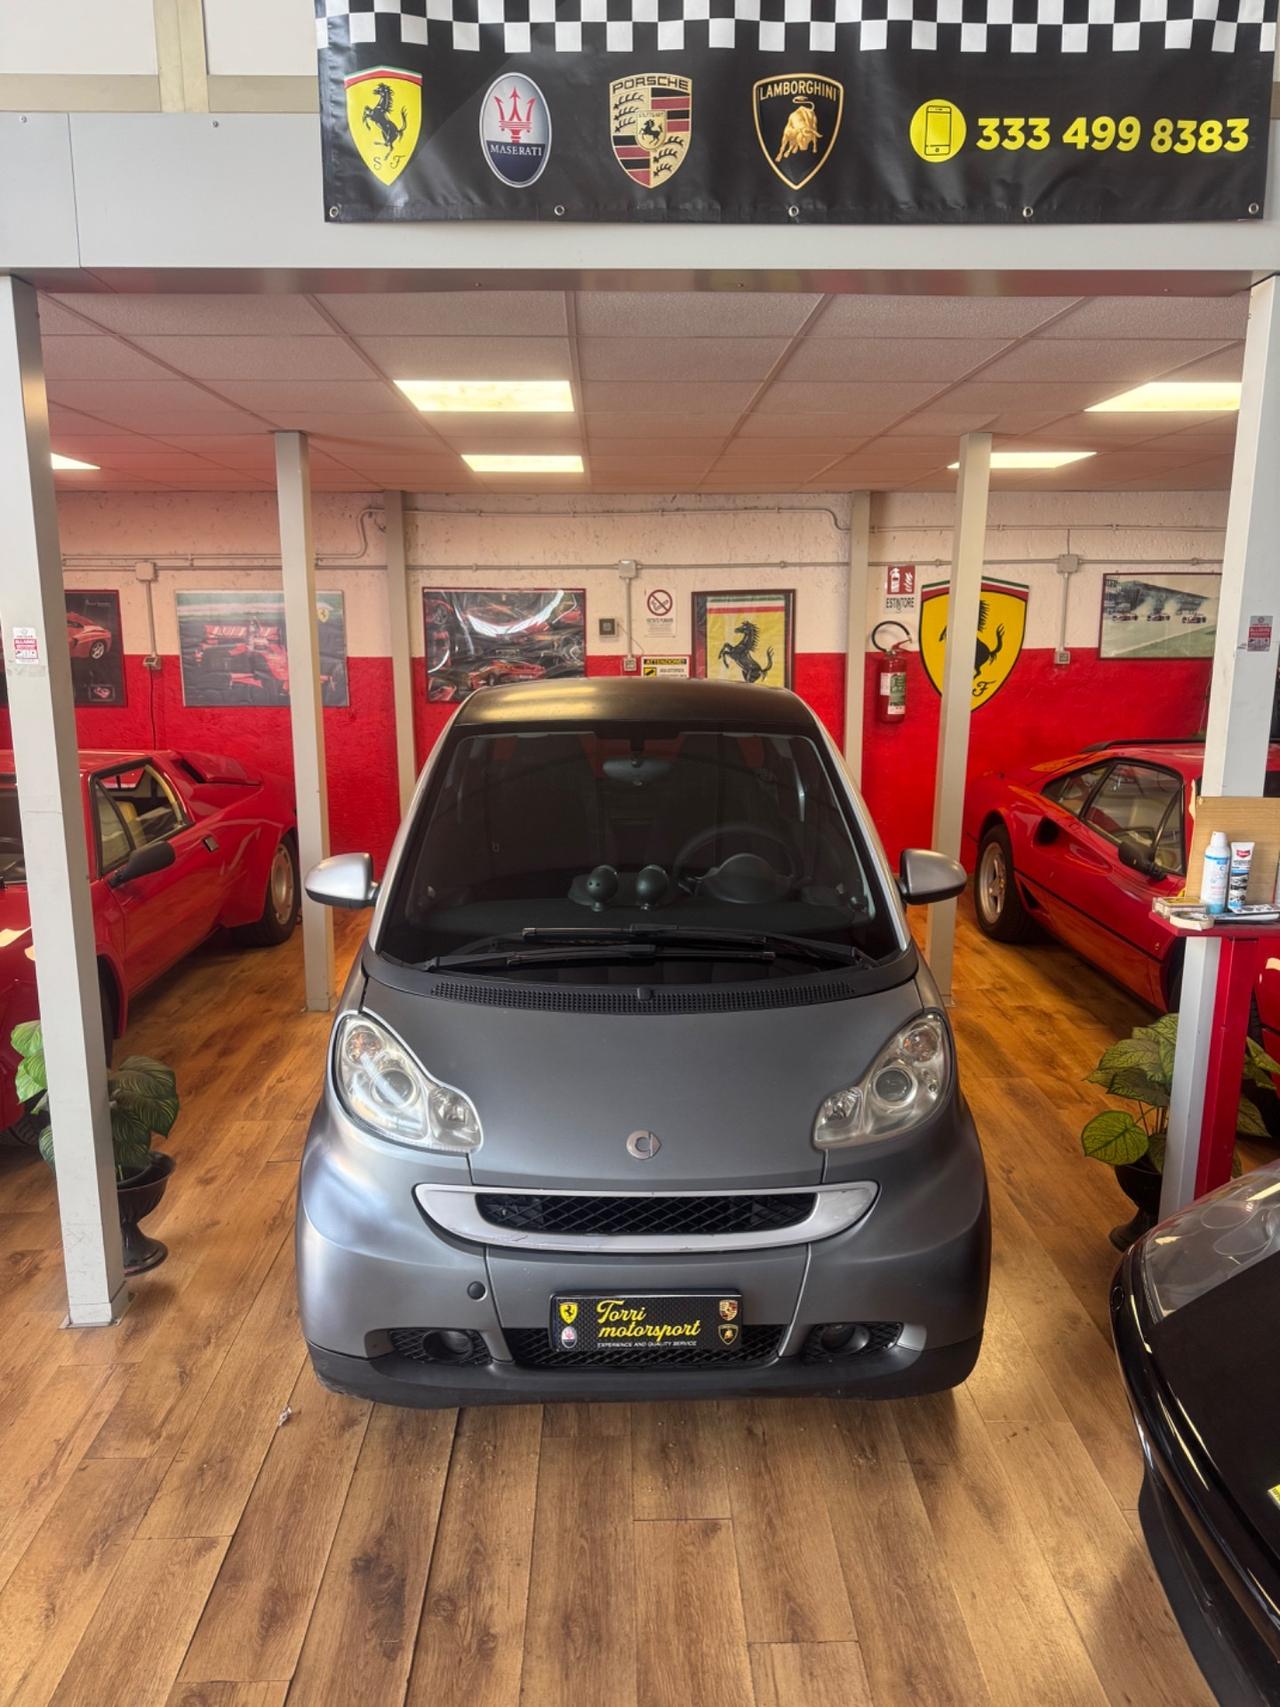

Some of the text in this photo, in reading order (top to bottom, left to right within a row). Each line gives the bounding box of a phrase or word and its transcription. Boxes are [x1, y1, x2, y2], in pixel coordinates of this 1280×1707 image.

[612, 76, 689, 94] PORSCHE
[759, 79, 838, 102] LAMBORGHINI
[975, 116, 1250, 154] 333 499 8383
[490, 144, 543, 157] MASERATI
[886, 597, 914, 609] ESTINTORE
[596, 1299, 647, 1323] Torri
[597, 1320, 701, 1342] motorsport
